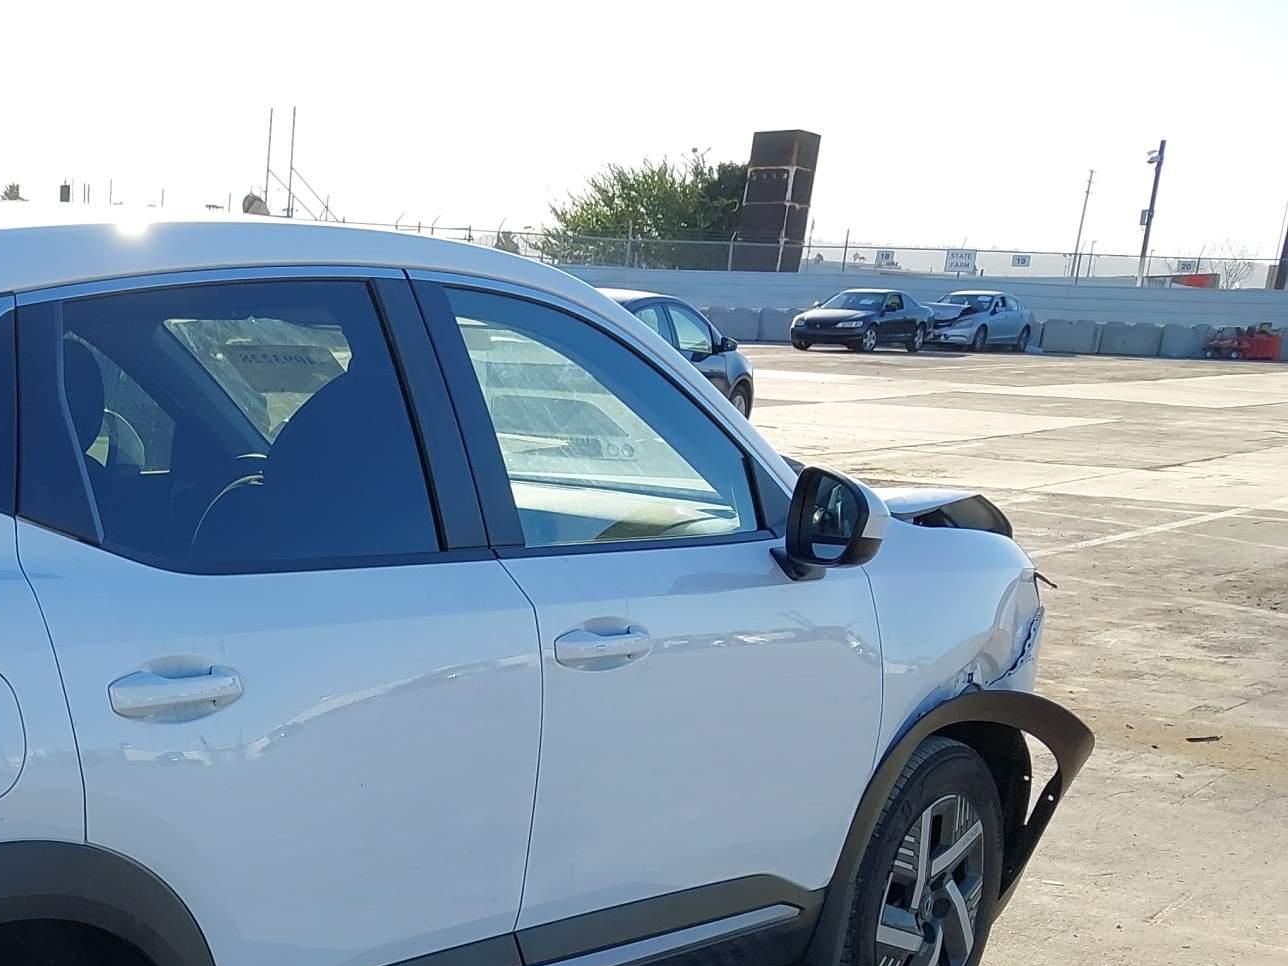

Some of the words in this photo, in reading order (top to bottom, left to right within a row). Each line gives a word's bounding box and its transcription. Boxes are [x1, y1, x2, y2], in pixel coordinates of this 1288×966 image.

[880, 252, 890, 261] 18
[950, 252, 973, 261] STATE
[950, 262, 970, 270] FARM
[1016, 257, 1027, 266] 19
[1181, 263, 1192, 271] 20
